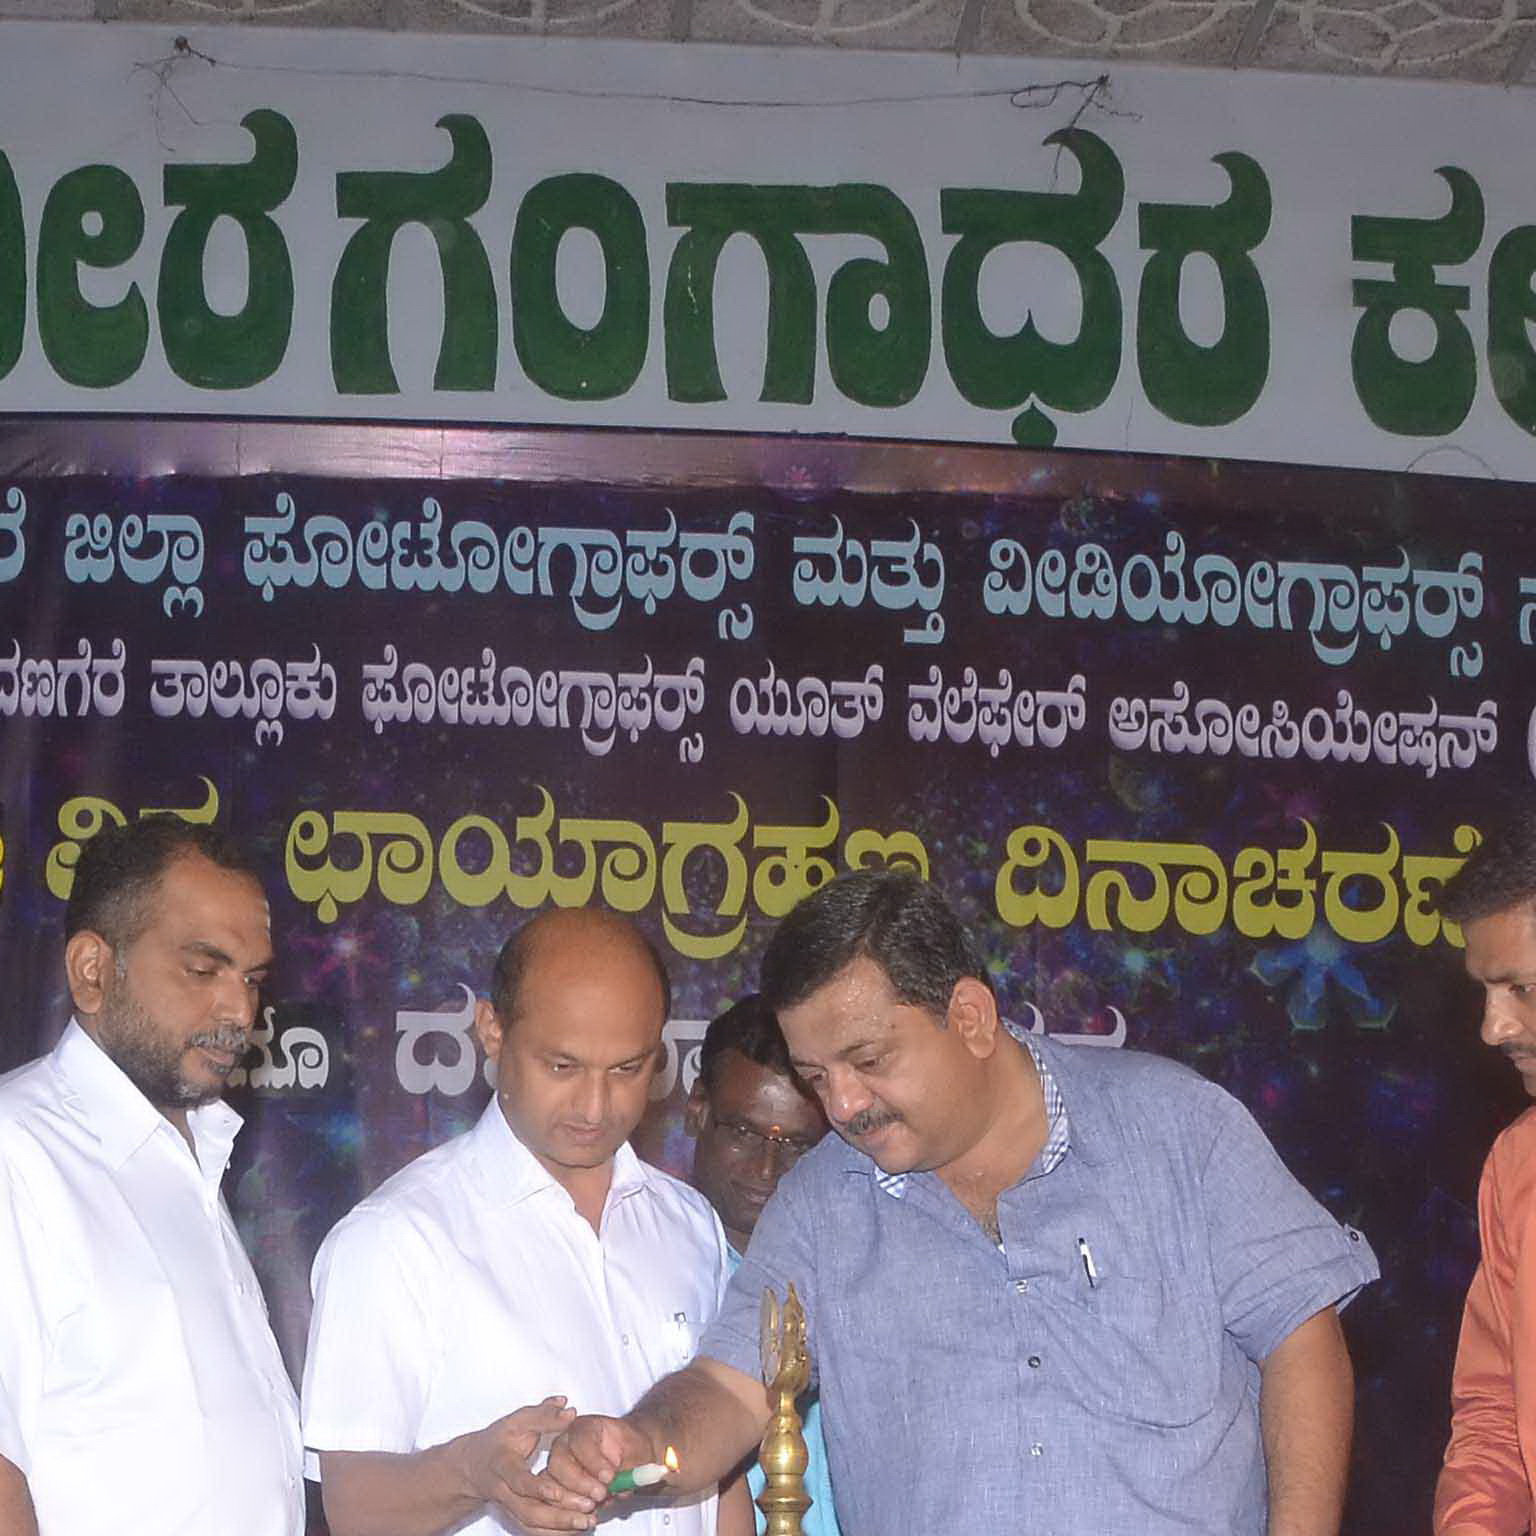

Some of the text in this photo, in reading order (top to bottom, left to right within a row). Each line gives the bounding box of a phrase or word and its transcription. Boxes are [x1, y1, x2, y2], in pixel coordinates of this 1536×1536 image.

[64, 513, 204, 618] ಜಿಲ್ಲಾ
[243, 492, 756, 640] ಫೋಟೋಗ್ರಾಫರ್ಸ್
[792, 513, 946, 645] ಮತ್ತು
[984, 530, 1484, 679] ವೀಡಿಯೋಗ್ರಾಫರ್ಸ್
[150, 643, 338, 746] ತಾಲ್ಲೂಕು
[361, 644, 706, 764] ಫೋಟೋಗ್ರಾಫರ್ಸ್
[729, 659, 885, 738] ಯೂತ್
[1108, 680, 1498, 779] ಅಸೋಸಿಯೇಷನ್
